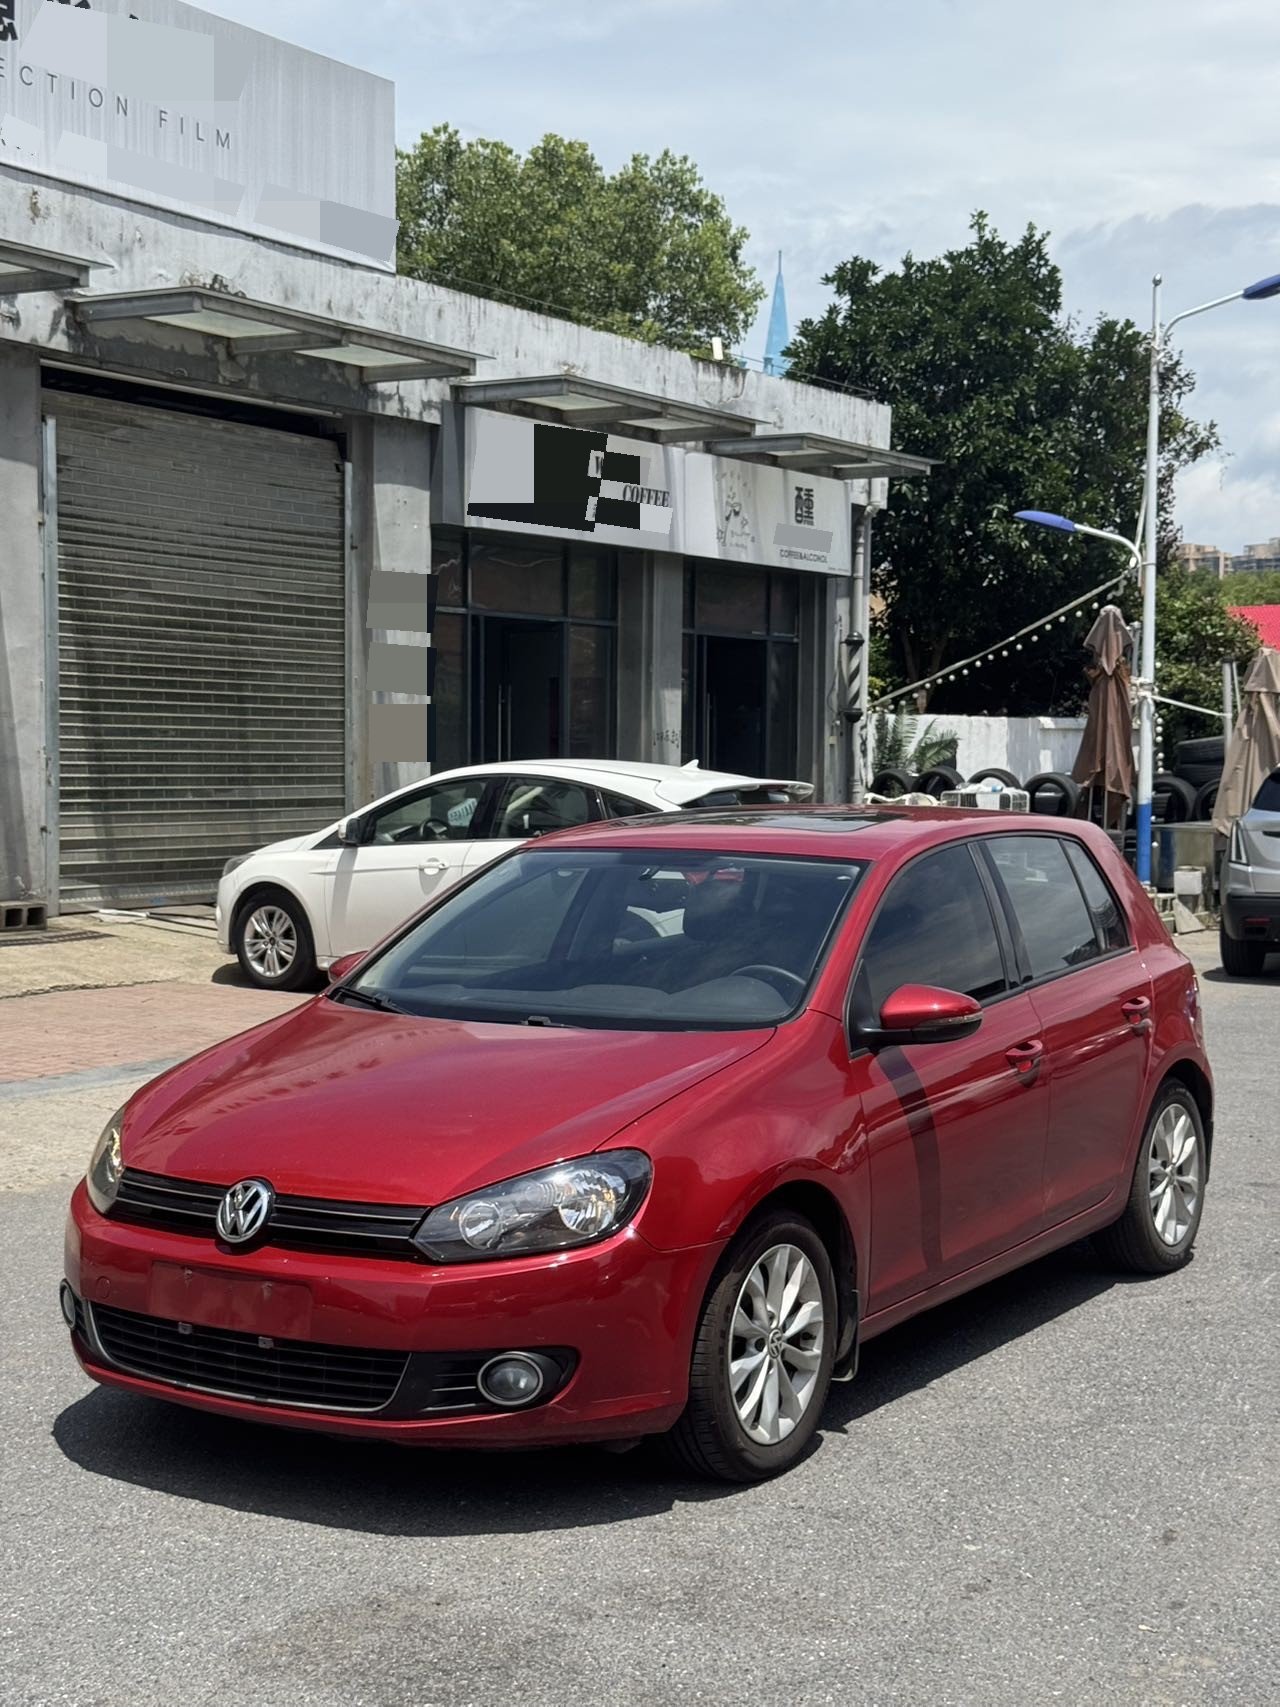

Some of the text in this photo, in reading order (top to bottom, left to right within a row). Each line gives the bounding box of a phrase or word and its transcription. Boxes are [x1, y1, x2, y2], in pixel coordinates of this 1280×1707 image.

[159, 110, 231, 150] FILM
[622, 484, 670, 508] COFFEE
[217, 1180, 268, 1243] VW
